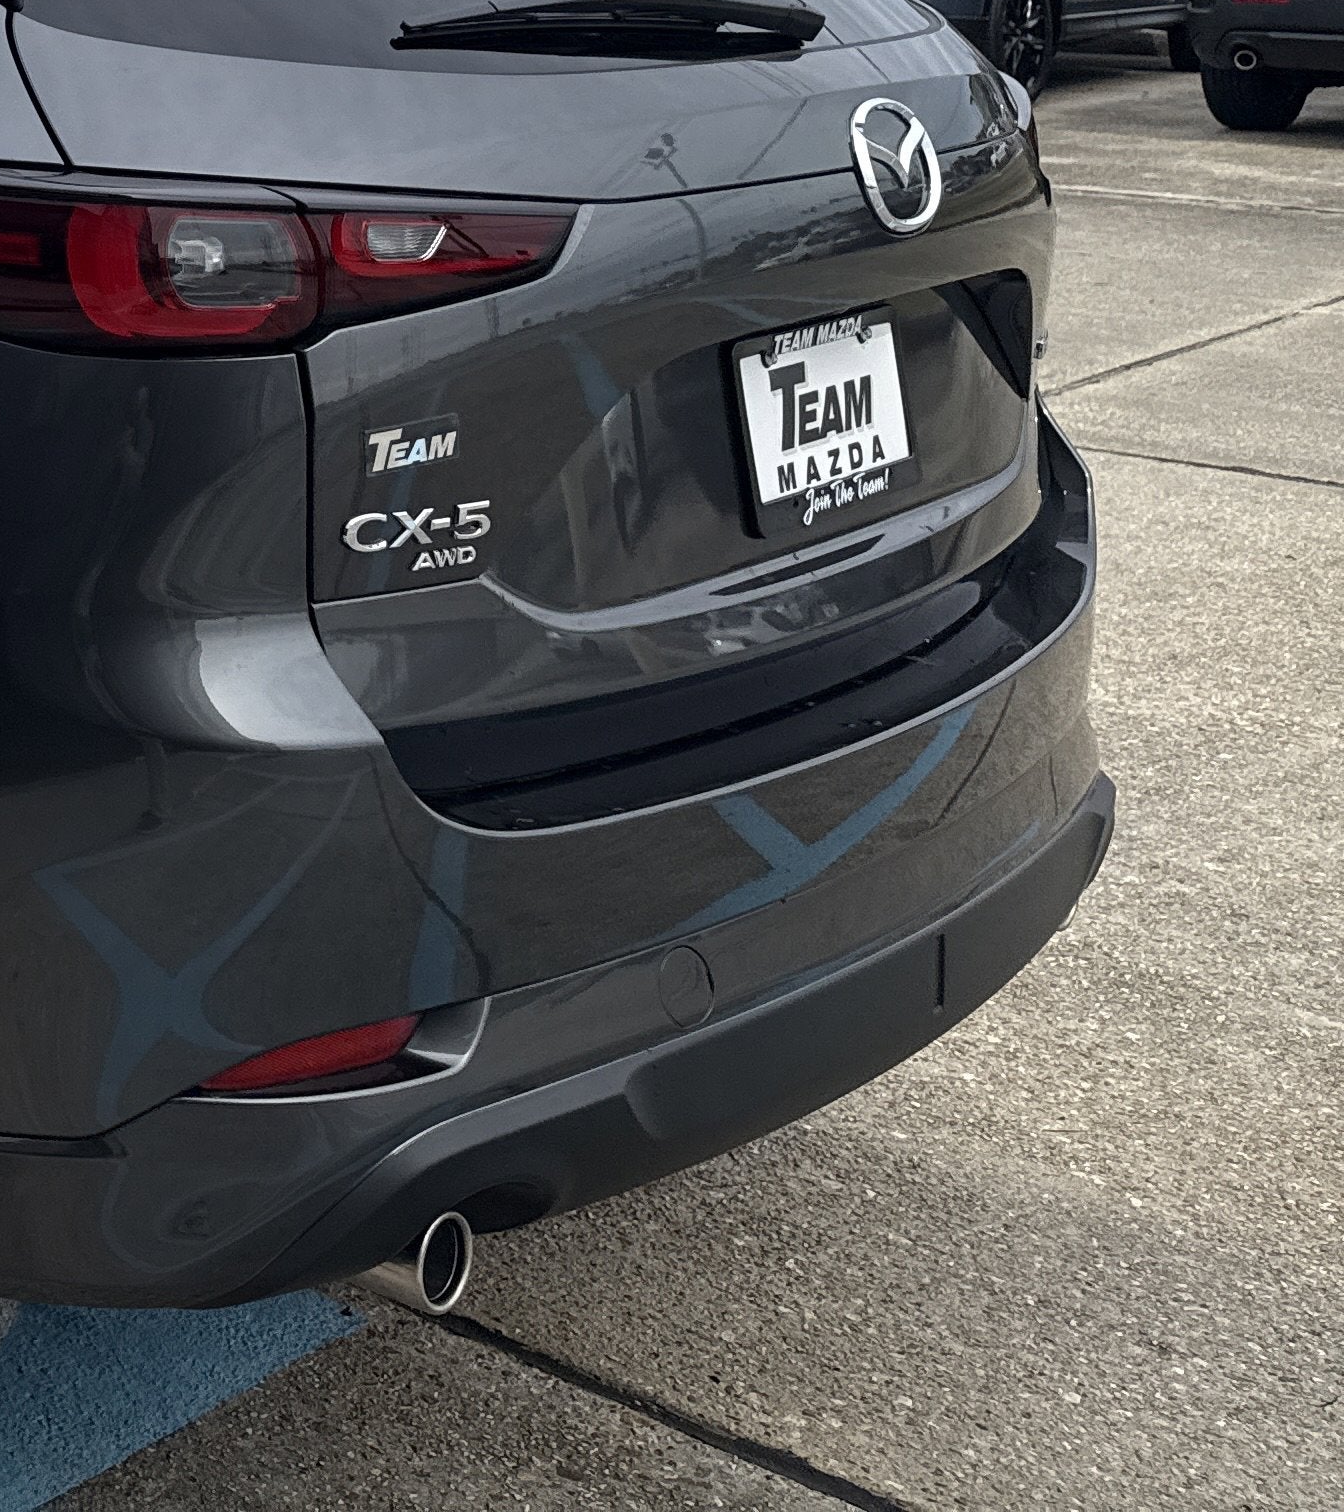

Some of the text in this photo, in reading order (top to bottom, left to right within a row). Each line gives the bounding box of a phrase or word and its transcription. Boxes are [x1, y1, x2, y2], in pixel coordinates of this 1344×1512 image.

[773, 314, 863, 355] TEAM MAZDA
[768, 360, 872, 452] TEAM
[368, 428, 457, 473] TEAM
[777, 434, 886, 493] MAZDA
[803, 468, 890, 526] Join The Team!
[342, 499, 491, 552] CX-5
[412, 545, 477, 571] AWD
